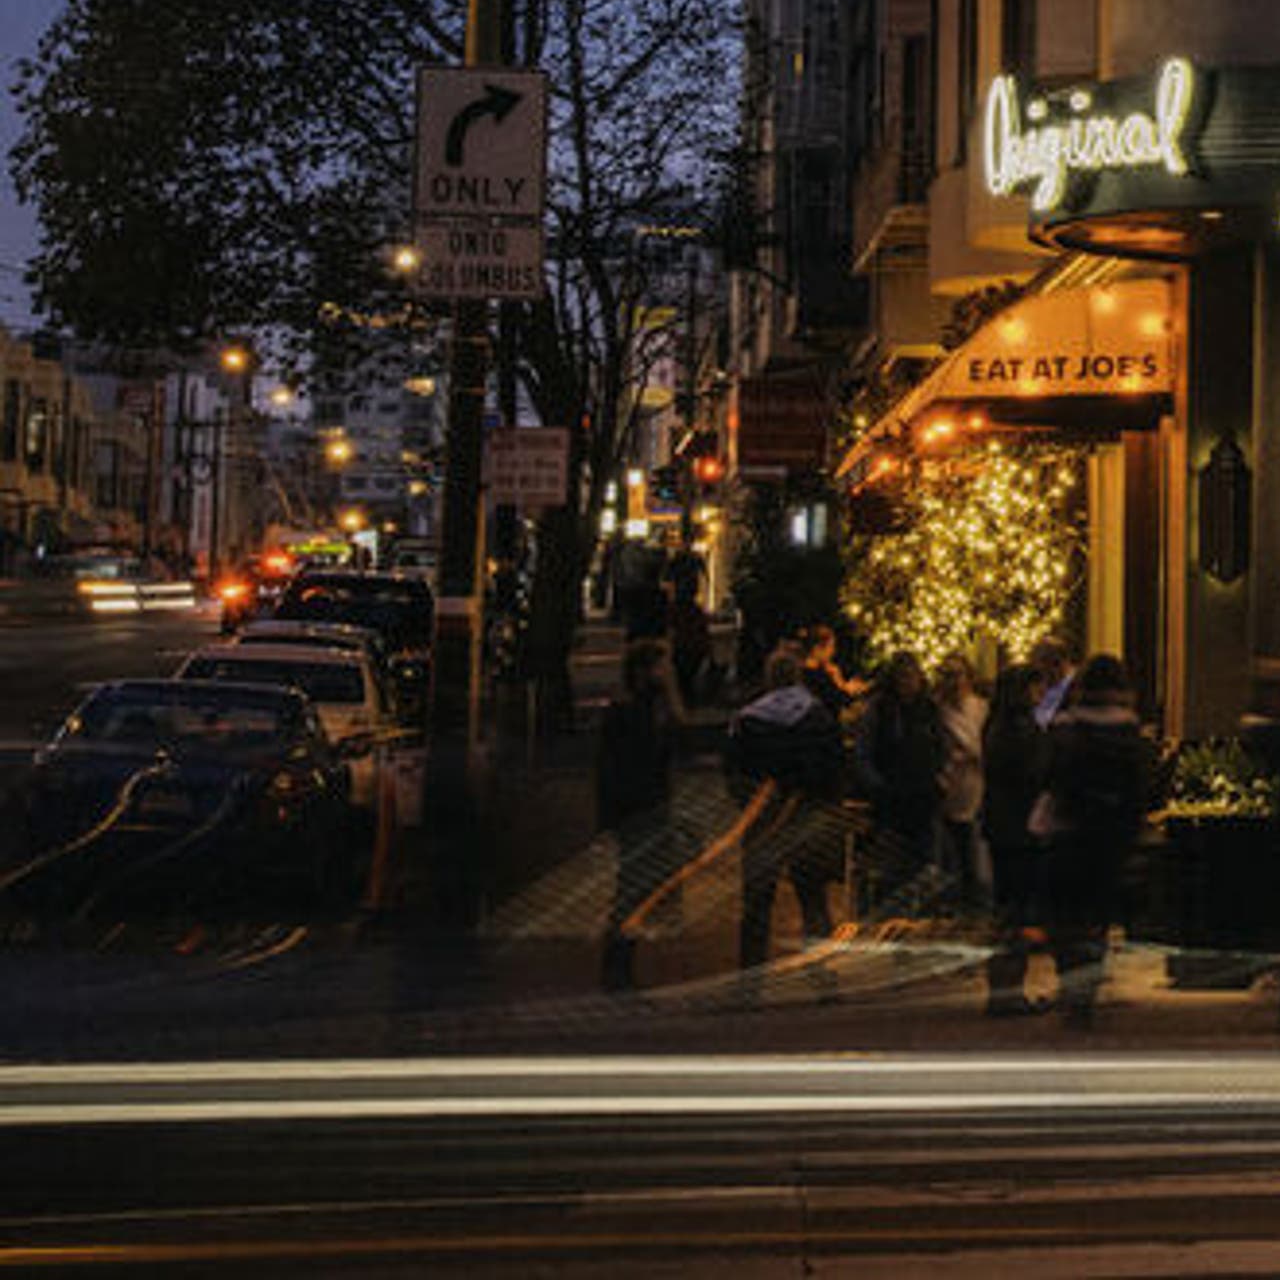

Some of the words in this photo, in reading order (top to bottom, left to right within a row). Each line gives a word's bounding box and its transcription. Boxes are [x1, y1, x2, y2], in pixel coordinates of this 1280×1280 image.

[985, 59, 1191, 211] Original
[432, 176, 524, 204] ONLY
[449, 231, 506, 256] ONTO
[418, 263, 536, 291] COLUMBUS
[969, 359, 1022, 381] EAT
[1034, 357, 1070, 380] AT
